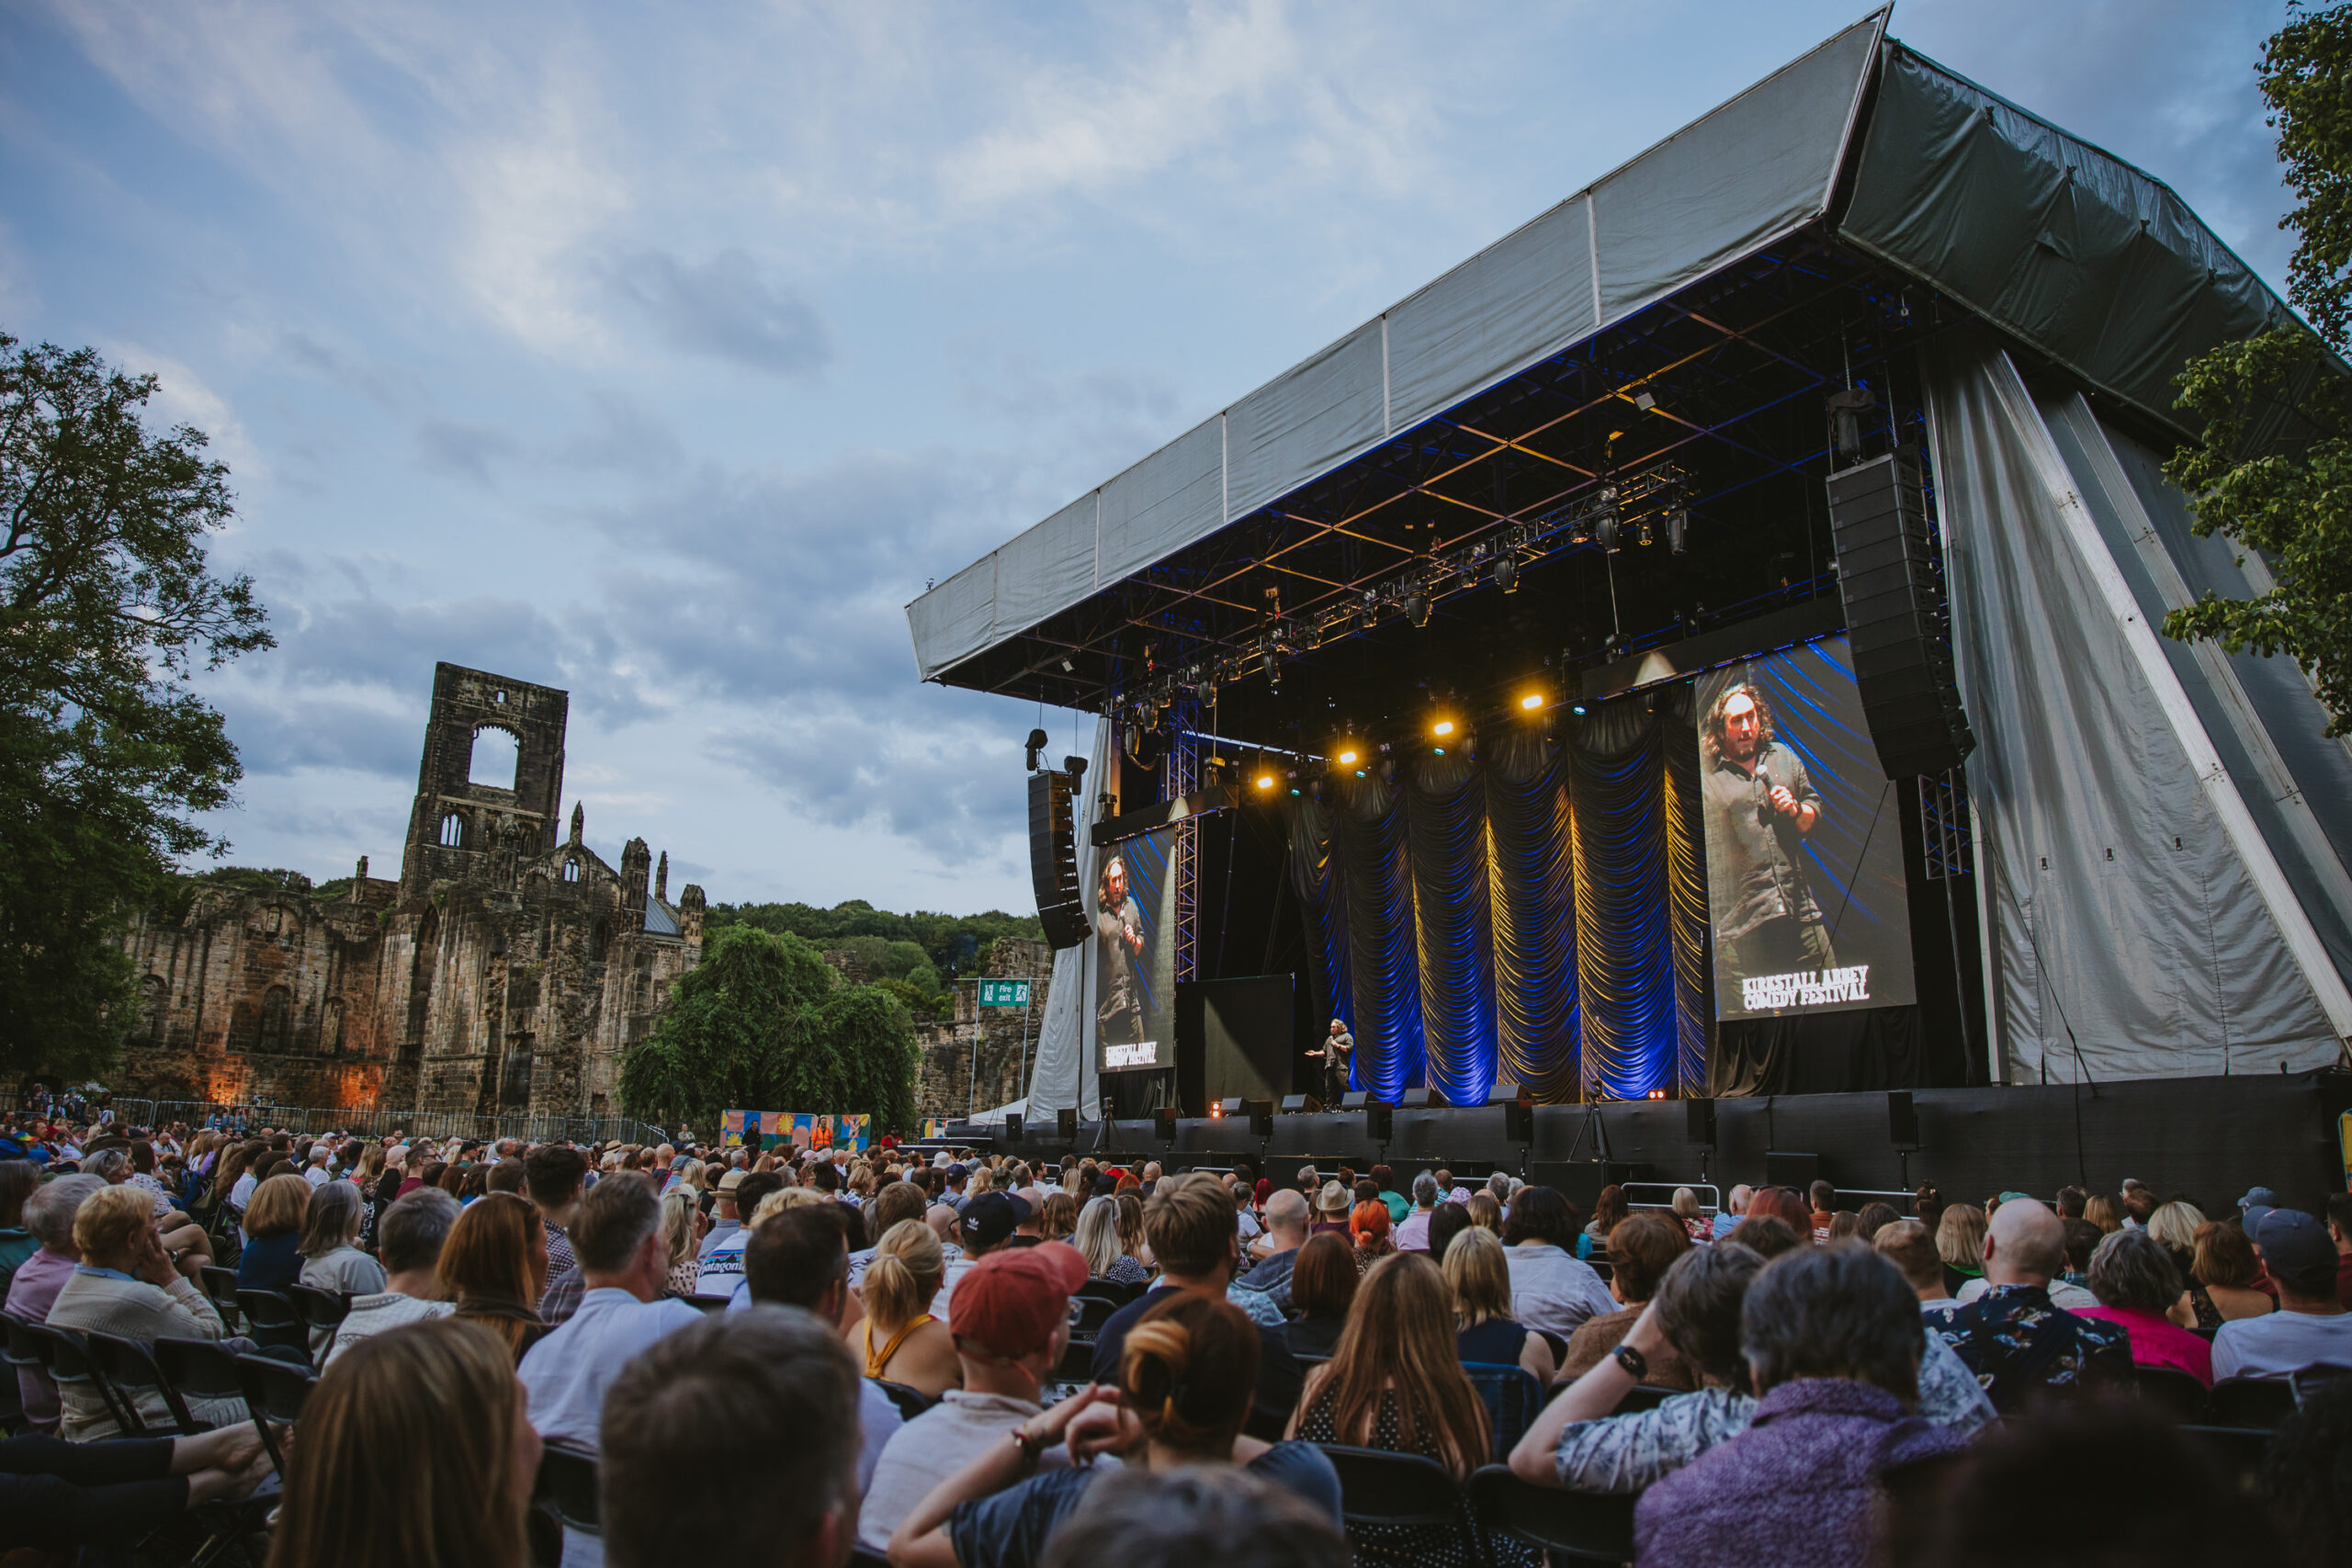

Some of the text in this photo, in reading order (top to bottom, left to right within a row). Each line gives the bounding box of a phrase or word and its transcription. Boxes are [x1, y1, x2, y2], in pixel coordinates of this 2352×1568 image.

[1000, 985, 1012, 993] Fire
[1742, 965, 1869, 995] KIRKSTALL ABBEY
[999, 994, 1011, 1002] exit
[1744, 982, 1870, 1010] COMEDY FESTIVAL
